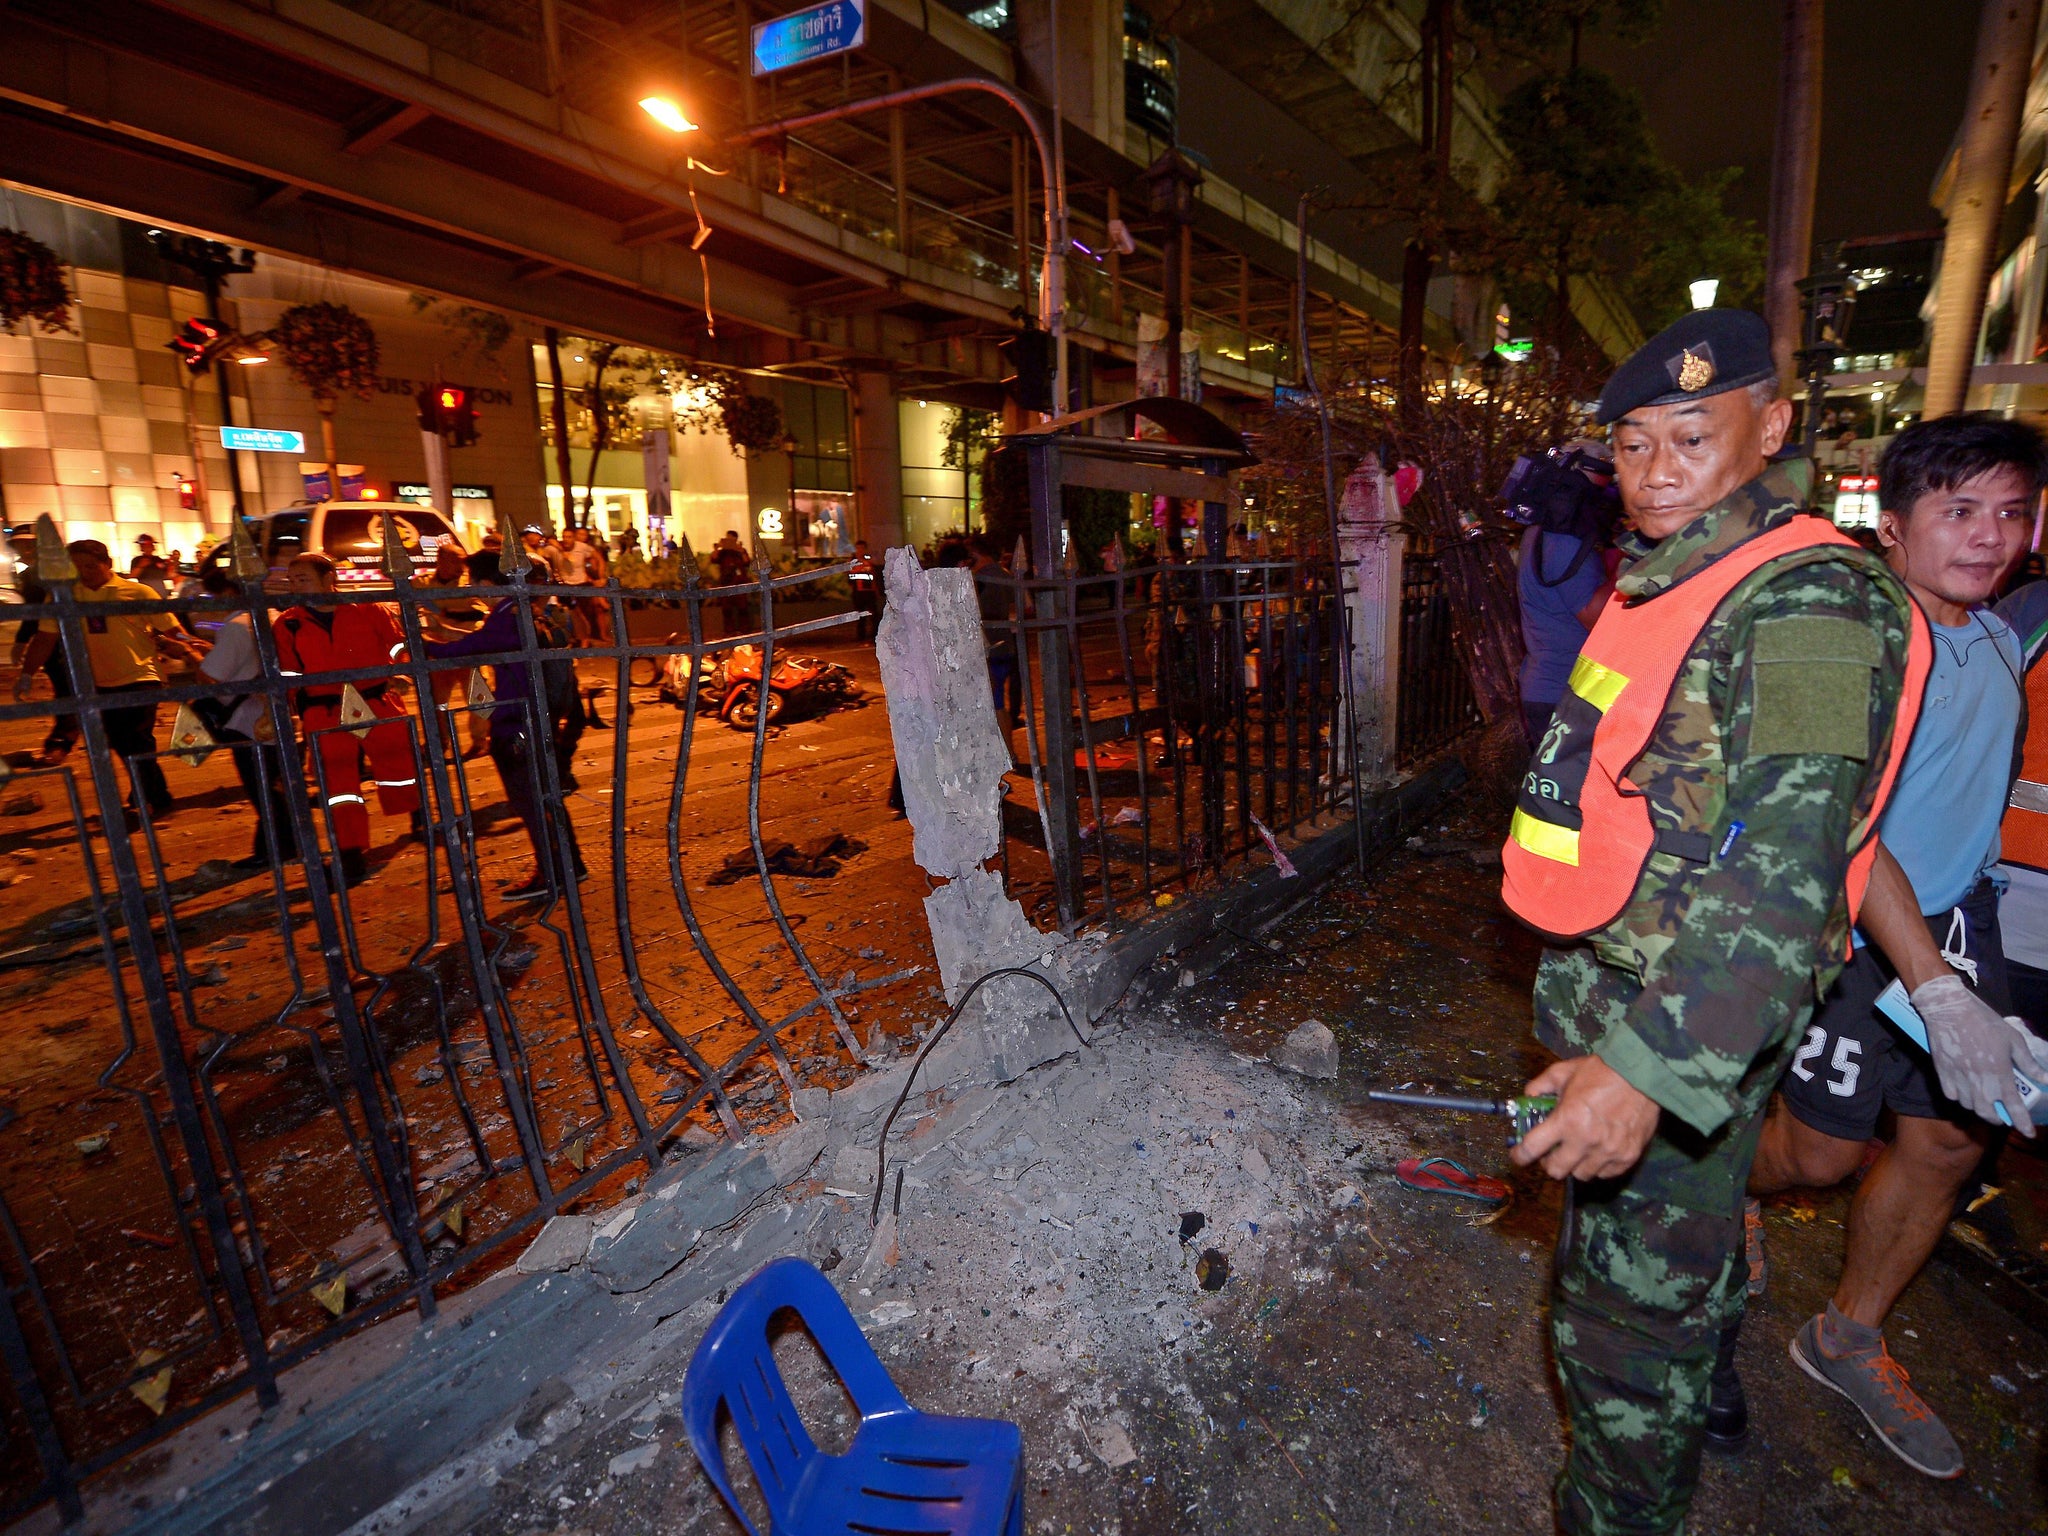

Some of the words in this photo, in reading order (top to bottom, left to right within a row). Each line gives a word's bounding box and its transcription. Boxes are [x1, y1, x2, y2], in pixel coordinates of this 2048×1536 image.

[788, 4, 842, 43] ราชดำริ
[1791, 1025, 1862, 1098] 25
